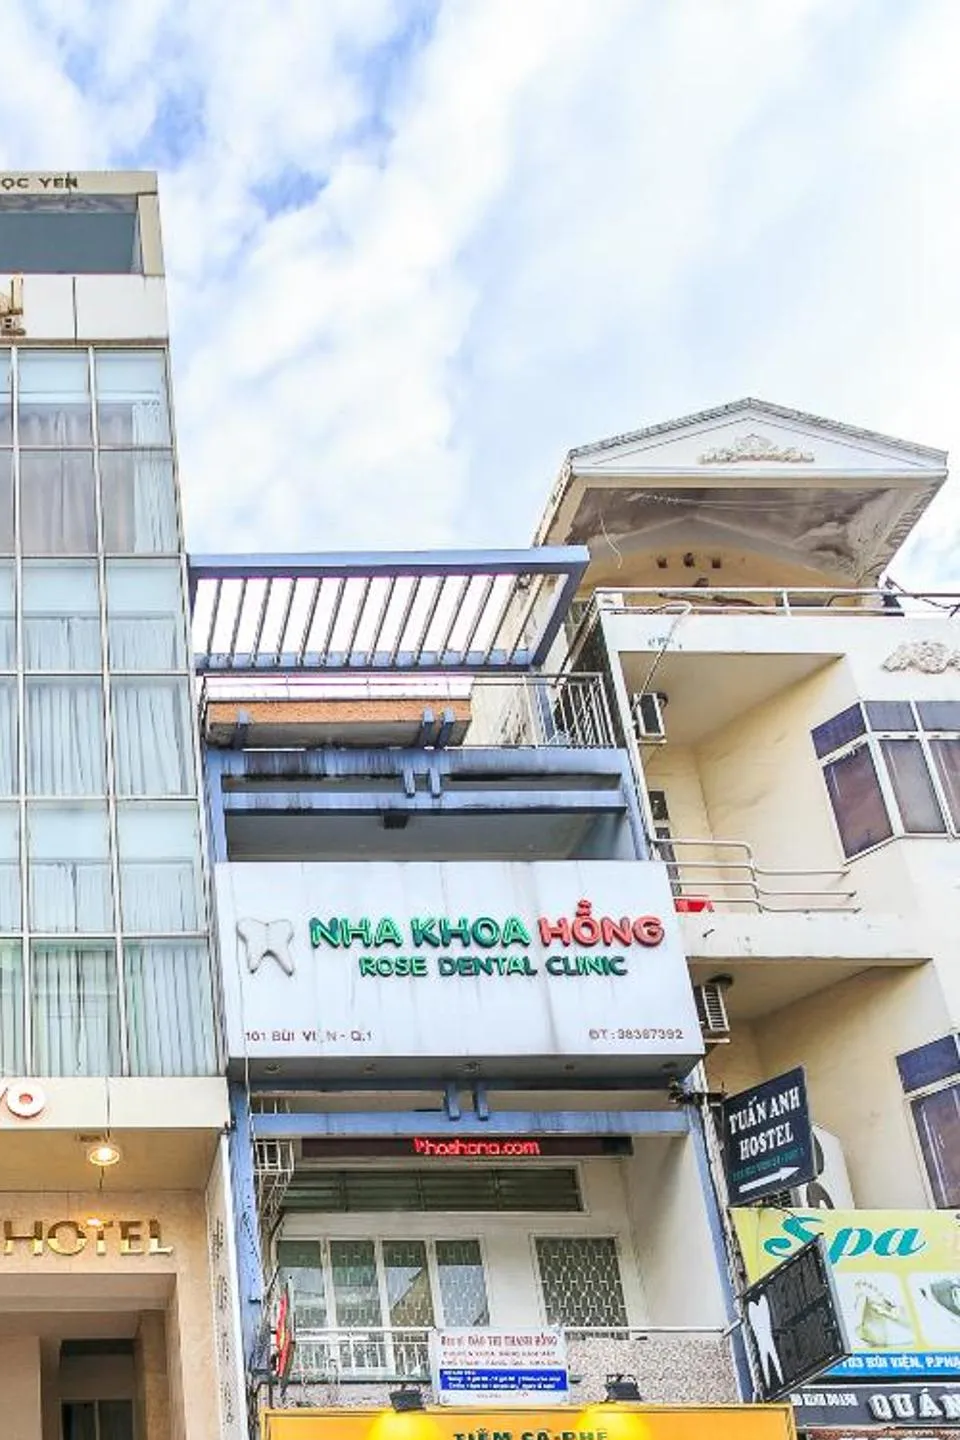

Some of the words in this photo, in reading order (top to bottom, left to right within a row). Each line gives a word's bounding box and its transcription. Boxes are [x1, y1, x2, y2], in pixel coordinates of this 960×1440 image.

[310, 917, 403, 948] NHA
[412, 917, 531, 947] KHOA
[539, 899, 665, 948] HỒNG
[359, 957, 427, 977] ROSE
[440, 956, 537, 977] DENTAL
[546, 955, 628, 977] CLINIC
[769, 1085, 801, 1118] ANH
[739, 1121, 795, 1161] HOSTEL
[3, 1219, 174, 1258] HOTEL
[763, 1216, 928, 1266] Spa
